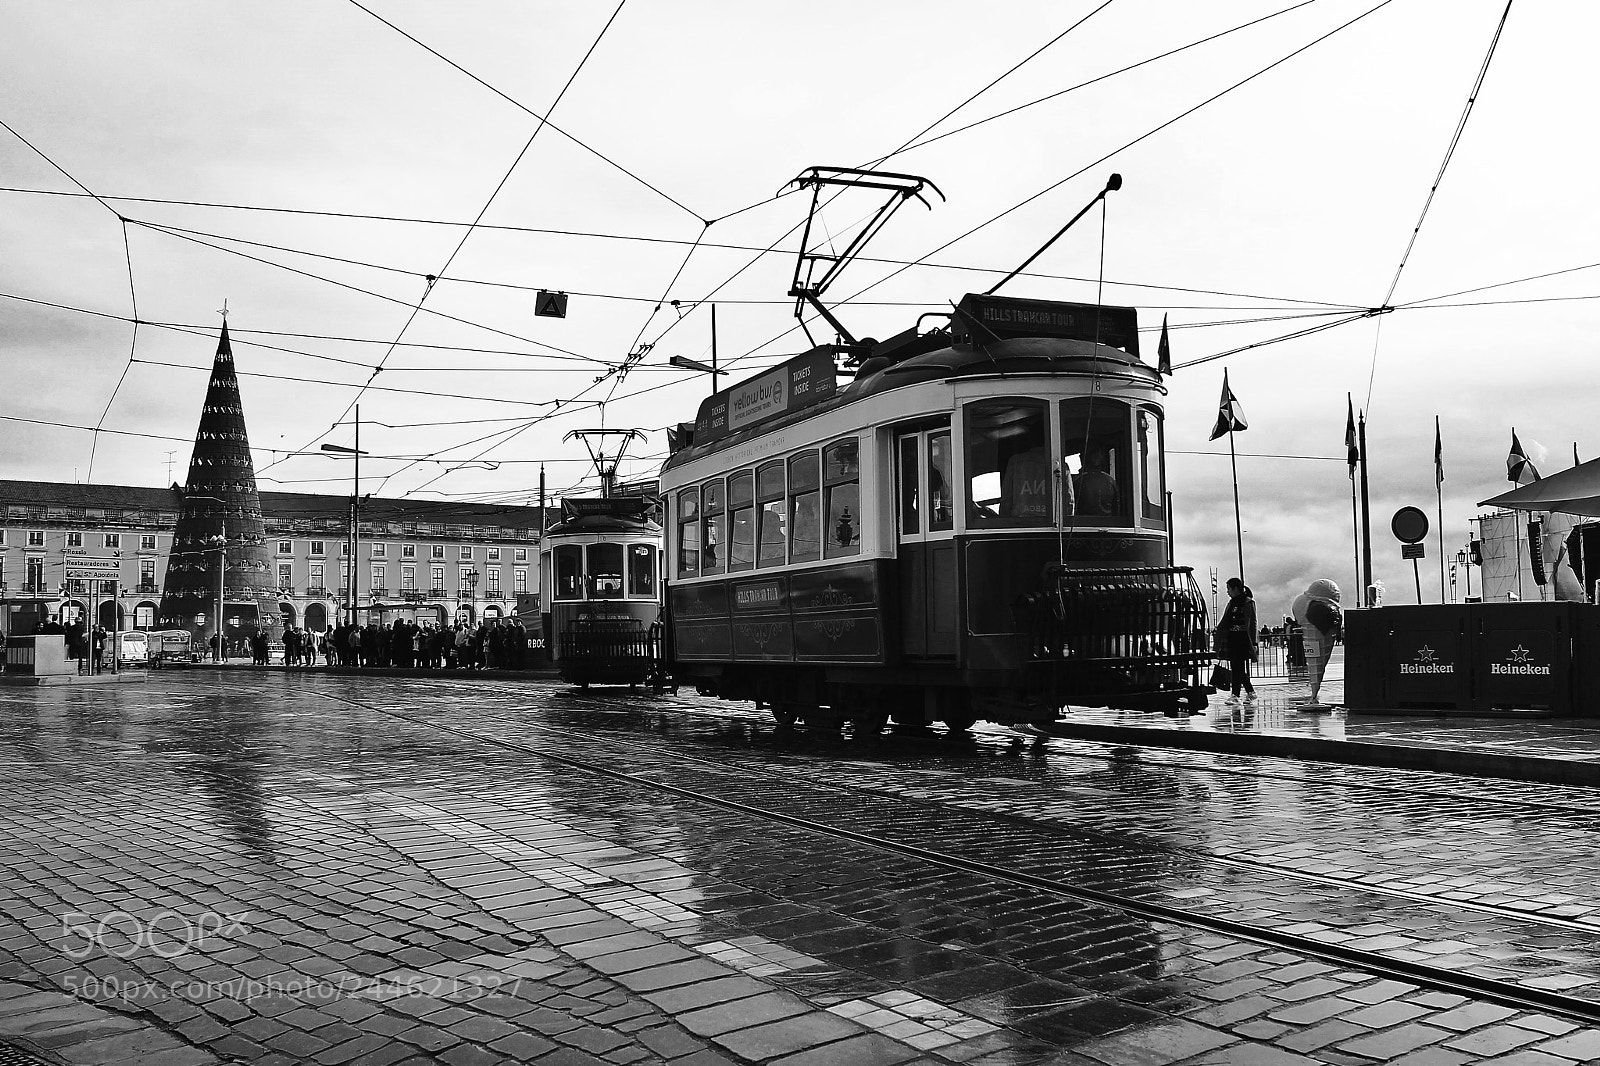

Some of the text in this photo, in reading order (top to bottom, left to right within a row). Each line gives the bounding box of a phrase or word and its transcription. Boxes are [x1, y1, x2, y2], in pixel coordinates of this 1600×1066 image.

[984, 307, 1011, 322] HILLS
[1051, 312, 1074, 327] TOUR
[793, 365, 811, 382] TICKETS
[794, 380, 810, 396] INSIDE
[1095, 380, 1102, 392] 8
[734, 389, 759, 412] yellow
[759, 384, 773, 401] bus
[711, 403, 726, 416] TICKETS
[711, 416, 724, 429] INSIDE
[66, 559, 109, 567] Restauradores
[1400, 663, 1454, 674] Heineken
[1491, 663, 1551, 675] Heineken
